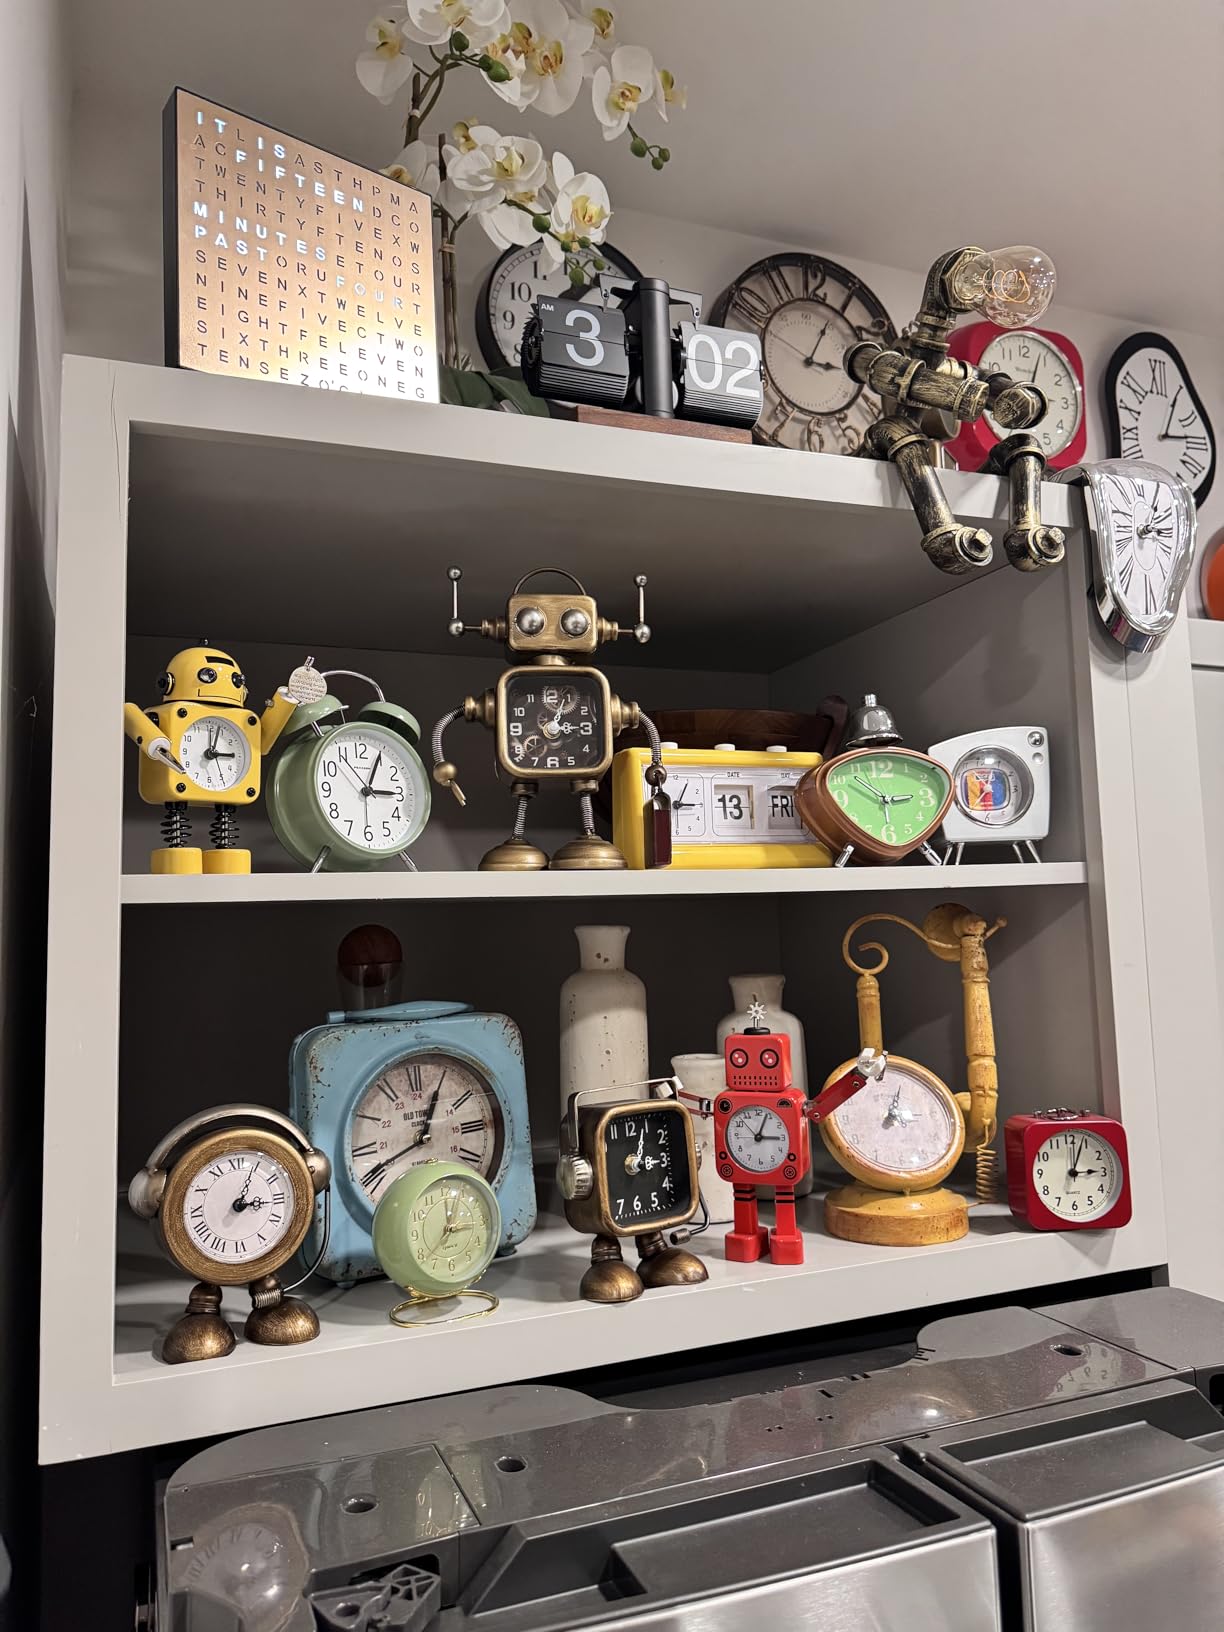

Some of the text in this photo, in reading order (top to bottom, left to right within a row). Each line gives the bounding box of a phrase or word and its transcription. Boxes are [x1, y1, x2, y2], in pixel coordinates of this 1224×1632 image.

[802, 261, 828, 302] 12
[511, 282, 531, 302] 10
[732, 286, 771, 329] 10
[503, 310, 514, 330] 9
[566, 310, 604, 366] 3
[1002, 347, 1012, 361] 11
[1018, 344, 1031, 358] 12
[688, 333, 760, 398] 02
[1054, 373, 1062, 387] 2
[1148, 358, 1168, 399] XII
[1121, 370, 1148, 405] XI
[1061, 396, 1069, 410] 3
[1119, 398, 1141, 421] X
[1055, 419, 1064, 431] 4
[1043, 432, 1051, 446] 5
[1122, 425, 1138, 441] IX
[1186, 436, 1208, 452] III
[1179, 451, 1205, 479] IV
[1143, 573, 1157, 615] VI
[527, 694, 535, 703] 11
[543, 690, 558, 703] 12
[567, 694, 571, 703] 1
[513, 707, 525, 716] 10
[580, 706, 588, 715] 2
[193, 725, 200, 733] 11
[510, 722, 522, 736] 9
[580, 722, 592, 735] 3
[184, 735, 192, 743] 10
[182, 747, 187, 755] 9
[338, 746, 347, 763] 11
[354, 742, 368, 760] 12
[515, 745, 522, 754] 8
[582, 744, 590, 753] 4
[185, 760, 190, 768] 8
[531, 757, 538, 766] 7
[546, 757, 559, 768] 6
[567, 756, 575, 765] 5
[323, 759, 337, 777] 10
[389, 765, 400, 782] 2
[850, 764, 860, 773] 11
[870, 761, 894, 778] 12
[904, 763, 908, 773] 1
[830, 775, 845, 785] 10
[919, 774, 928, 783] 2
[321, 781, 332, 798] 9
[395, 786, 405, 802] 3
[1012, 785, 1018, 794] 3
[834, 789, 848, 808] 9
[918, 788, 935, 807] 3
[329, 802, 339, 820] 8
[717, 794, 743, 820] 13
[771, 795, 794, 818] FRI
[391, 806, 402, 822] 4
[916, 810, 924, 822] 4
[985, 812, 991, 822] 6
[343, 819, 353, 836] 7
[364, 824, 374, 842] 6
[382, 821, 391, 837] 5
[881, 824, 897, 844] 6
[904, 824, 913, 834] 5
[406, 1065, 423, 1092] XII
[376, 1078, 399, 1102] XI
[411, 1092, 422, 1100] 24
[395, 1102, 405, 1110] 23
[451, 1089, 473, 1110] II
[403, 1111, 413, 1121] OLD
[446, 1109, 454, 1117] 14
[381, 1120, 391, 1128] 22
[452, 1125, 460, 1134] 15
[460, 1119, 484, 1134] III
[625, 1121, 637, 1137] 12
[644, 1118, 649, 1133] 1
[776, 1121, 782, 1129] 2
[610, 1124, 618, 1140] 11
[657, 1129, 666, 1144] 2
[379, 1141, 387, 1149] 21
[1050, 1139, 1059, 1149] 11
[1065, 1134, 1076, 1145] 12
[450, 1145, 458, 1153] 16
[1095, 1150, 1102, 1160] 2
[659, 1152, 668, 1168] 3
[747, 1153, 752, 1161] 7
[1037, 1151, 1049, 1162] 10
[229, 1157, 245, 1170] XII
[253, 1161, 260, 1172] I
[208, 1165, 224, 1180] XI
[1037, 1168, 1043, 1179] 9
[1100, 1166, 1107, 1177] 3
[266, 1173, 278, 1185] II
[662, 1176, 670, 1191] 4
[194, 1185, 208, 1196] X
[440, 1186, 451, 1197] 12
[1042, 1185, 1049, 1195] 8
[1097, 1184, 1104, 1194] 4
[273, 1192, 285, 1205] III
[425, 1195, 433, 1206] 11
[633, 1195, 641, 1211] 6
[650, 1191, 658, 1208] 5
[1055, 1196, 1061, 1207] 7
[1071, 1200, 1078, 1210] 6
[1087, 1195, 1093, 1205] 5
[190, 1205, 203, 1218] IX
[616, 1198, 625, 1215] 7
[269, 1213, 281, 1227] IV
[413, 1209, 425, 1222] 10
[193, 1221, 212, 1243] VIII
[257, 1233, 266, 1244] V
[411, 1229, 418, 1241] 9
[210, 1237, 226, 1253] VII
[235, 1241, 247, 1253] VI
[474, 1236, 480, 1246] 4
[417, 1248, 424, 1260] 8
[465, 1250, 471, 1262] 5
[431, 1258, 437, 1270] 7
[448, 1259, 455, 1271] 6
